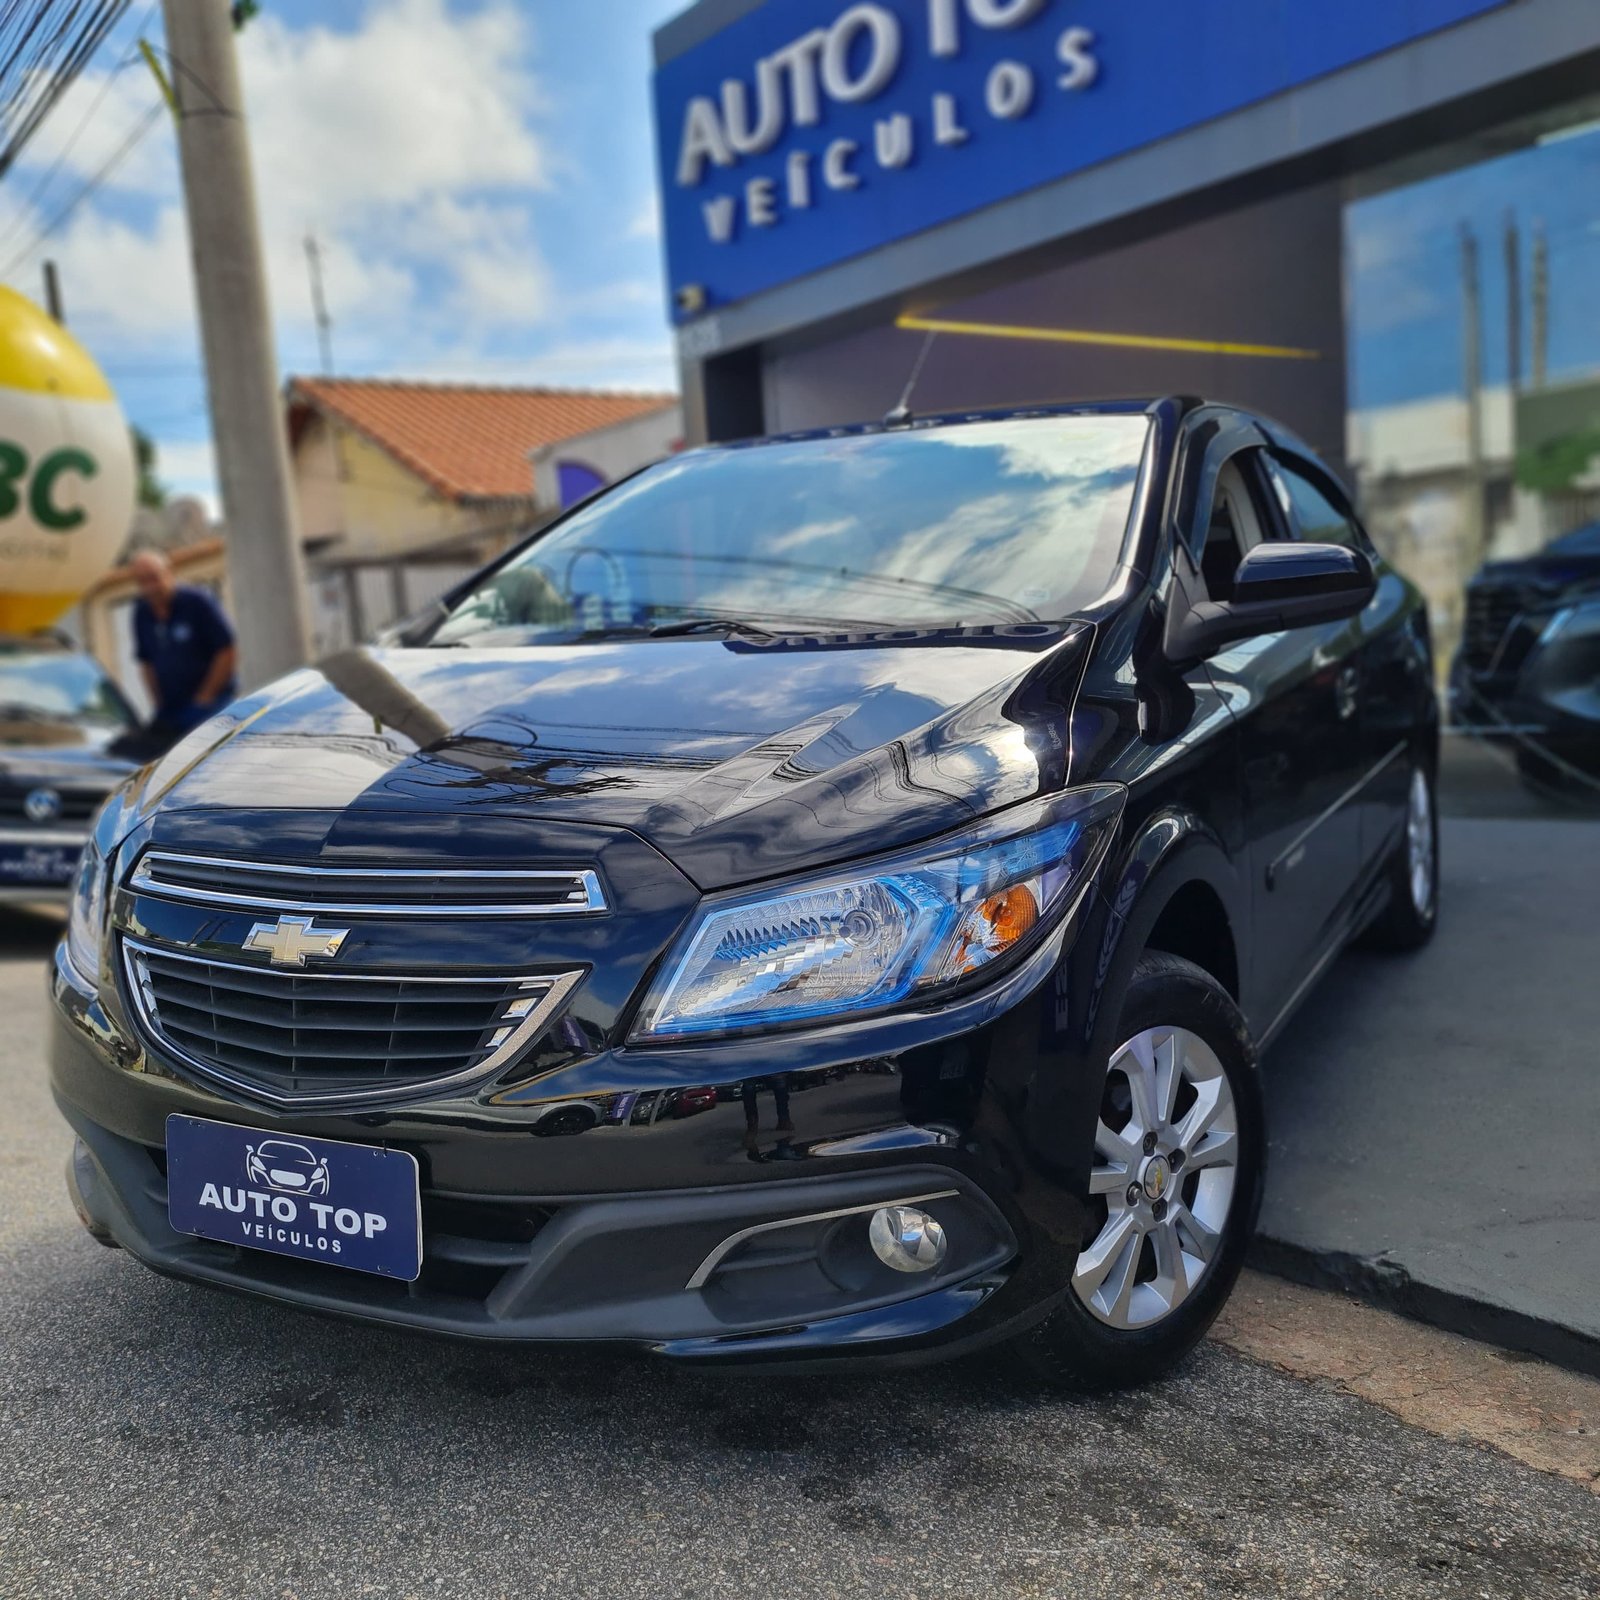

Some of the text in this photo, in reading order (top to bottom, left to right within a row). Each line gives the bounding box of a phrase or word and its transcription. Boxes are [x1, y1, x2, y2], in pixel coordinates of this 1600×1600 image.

[677, 2, 900, 186] AUTO
[199, 1183, 387, 1239] AUTO TOP
[242, 1221, 342, 1253] VEÍCULOS
